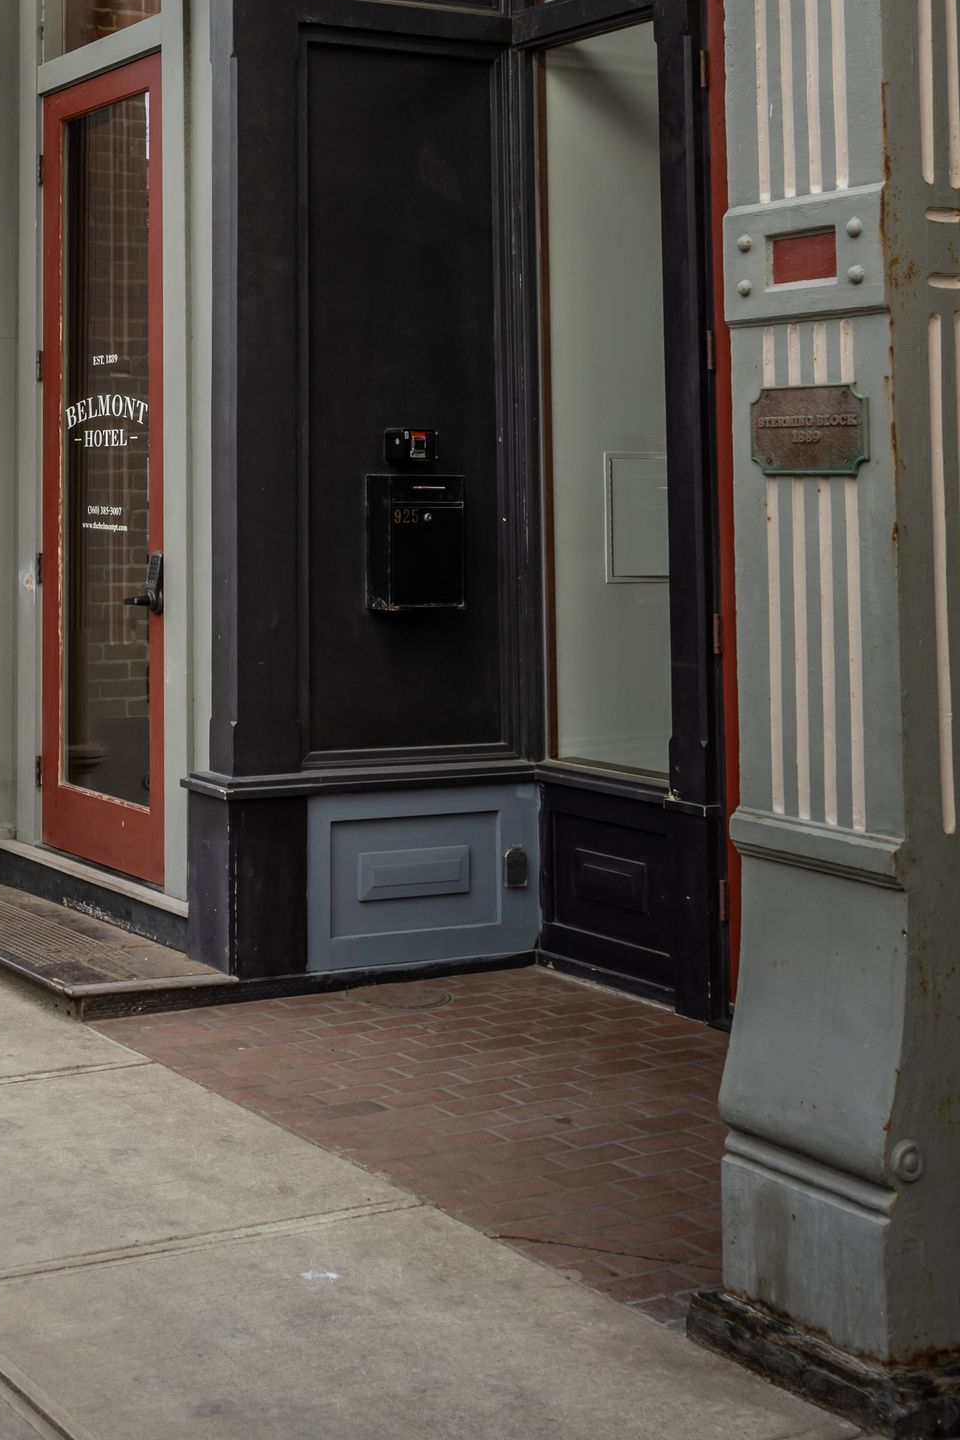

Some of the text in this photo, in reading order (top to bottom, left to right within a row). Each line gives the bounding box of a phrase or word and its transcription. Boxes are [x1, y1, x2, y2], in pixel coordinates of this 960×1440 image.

[65, 394, 148, 429] BELMONT
[816, 413, 858, 427] BLOCK
[84, 428, 127, 448] HOTEL
[791, 430, 821, 444] 1889
[394, 508, 419, 525] 925
